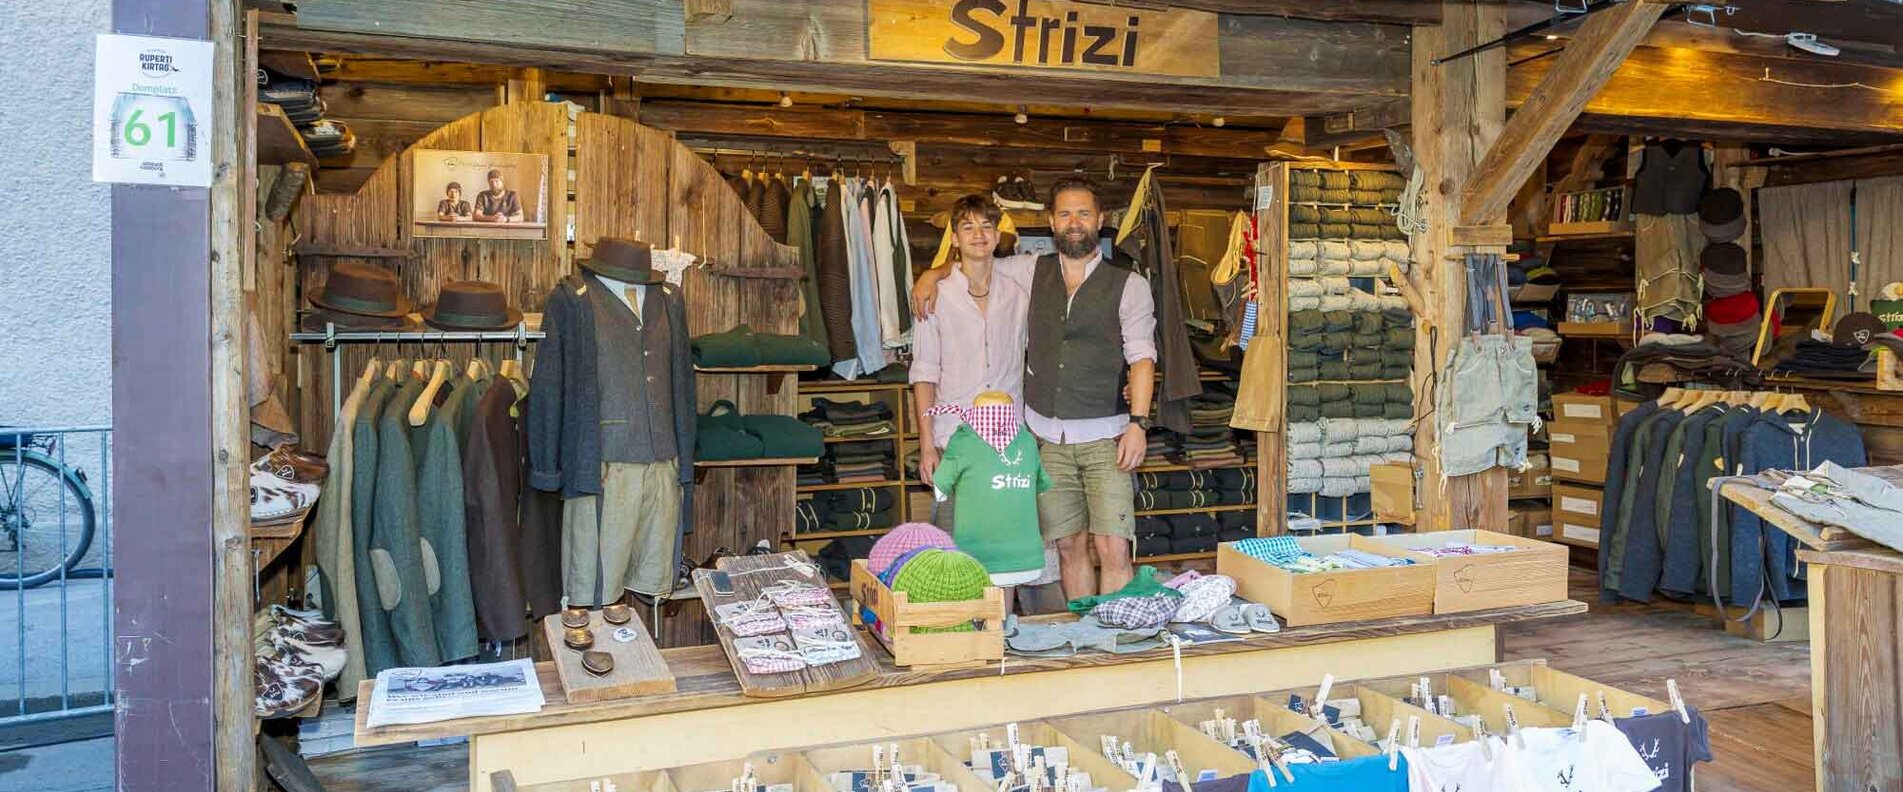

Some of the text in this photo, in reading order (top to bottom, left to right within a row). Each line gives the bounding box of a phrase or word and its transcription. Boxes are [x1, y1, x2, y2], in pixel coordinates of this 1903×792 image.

[943, 0, 1140, 67] Strizi
[139, 53, 173, 64] RUPERTI
[141, 62, 170, 72] KIRTAG
[131, 83, 178, 95] Domplatz
[124, 109, 176, 148] 61
[991, 474, 1031, 489] Strizi
